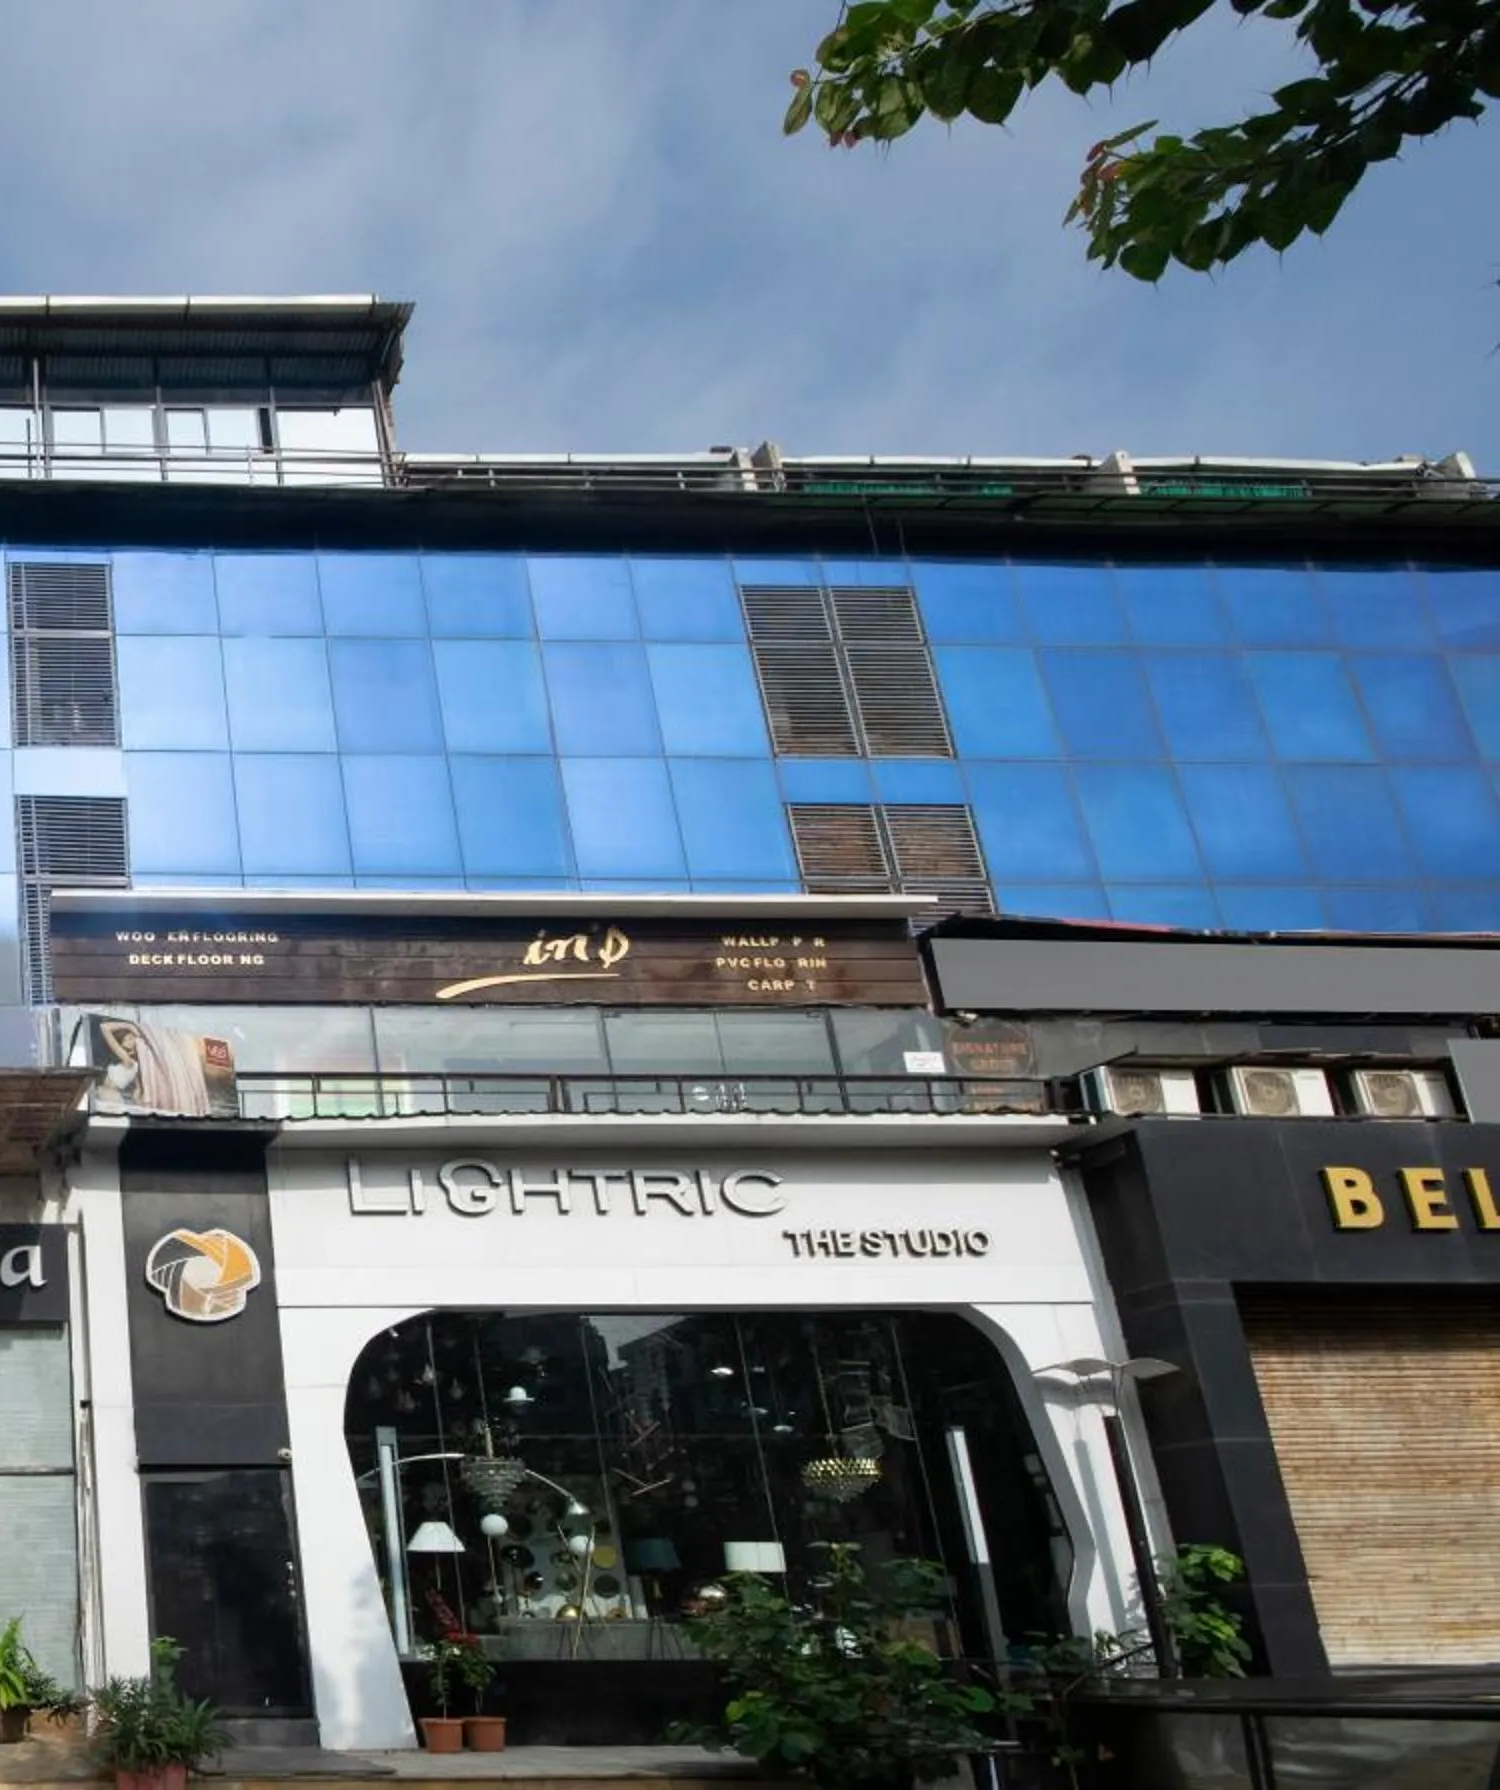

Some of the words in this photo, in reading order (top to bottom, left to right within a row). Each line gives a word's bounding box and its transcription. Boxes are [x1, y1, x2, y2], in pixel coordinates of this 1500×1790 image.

[129, 954, 174, 965] DECK
[177, 954, 265, 965] FLOORNG
[715, 957, 750, 969] PVC
[347, 1155, 788, 1218] LIGHTRIC
[1322, 1167, 1500, 1230] BEL
[781, 1228, 855, 1258] THE
[858, 1228, 990, 1258] STUDIO
